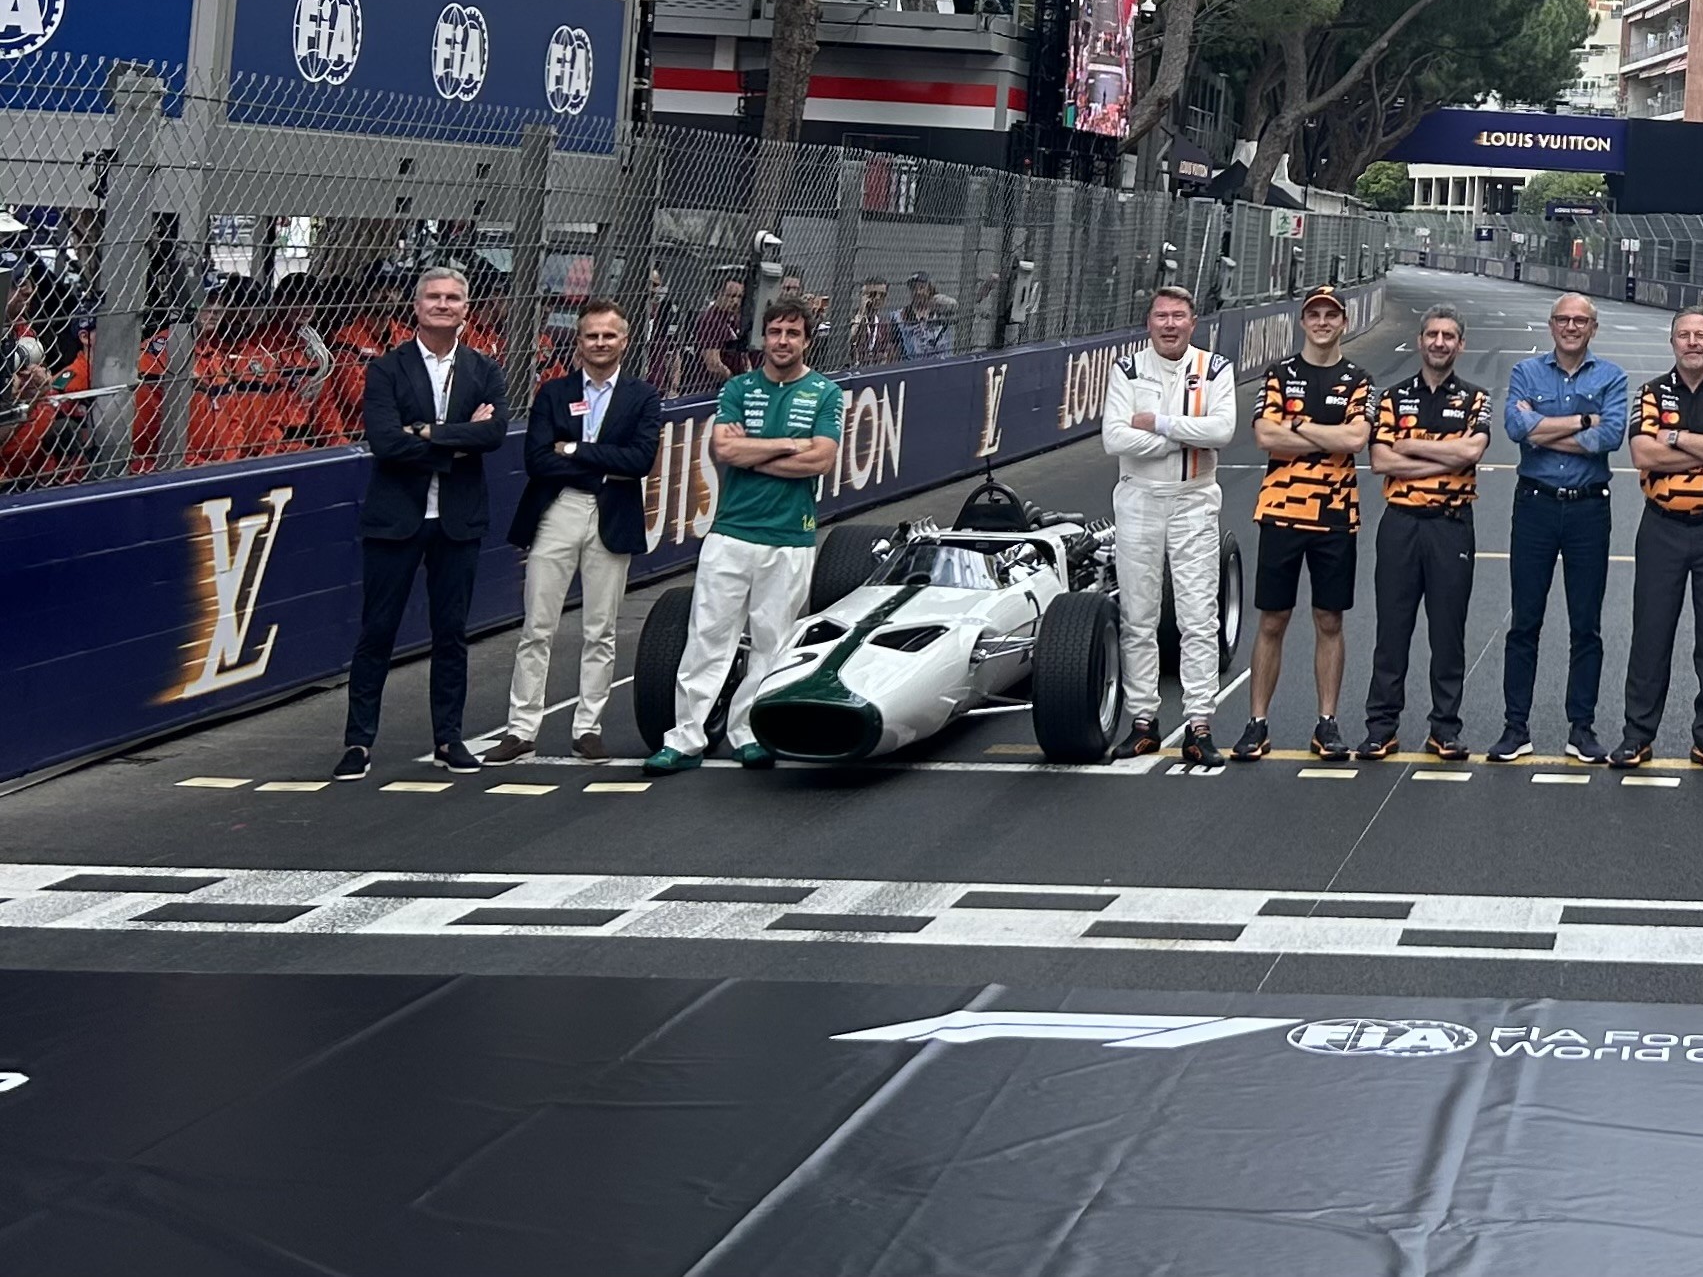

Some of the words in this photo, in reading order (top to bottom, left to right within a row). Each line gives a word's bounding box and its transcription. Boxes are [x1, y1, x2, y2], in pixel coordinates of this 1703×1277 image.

[1481, 131, 1534, 148] LOUIS
[1538, 134, 1611, 152] VUITTON
[1062, 346, 1117, 430] LOUI
[1491, 1025, 1589, 1044] FIA
[1489, 1041, 1670, 1063] World
